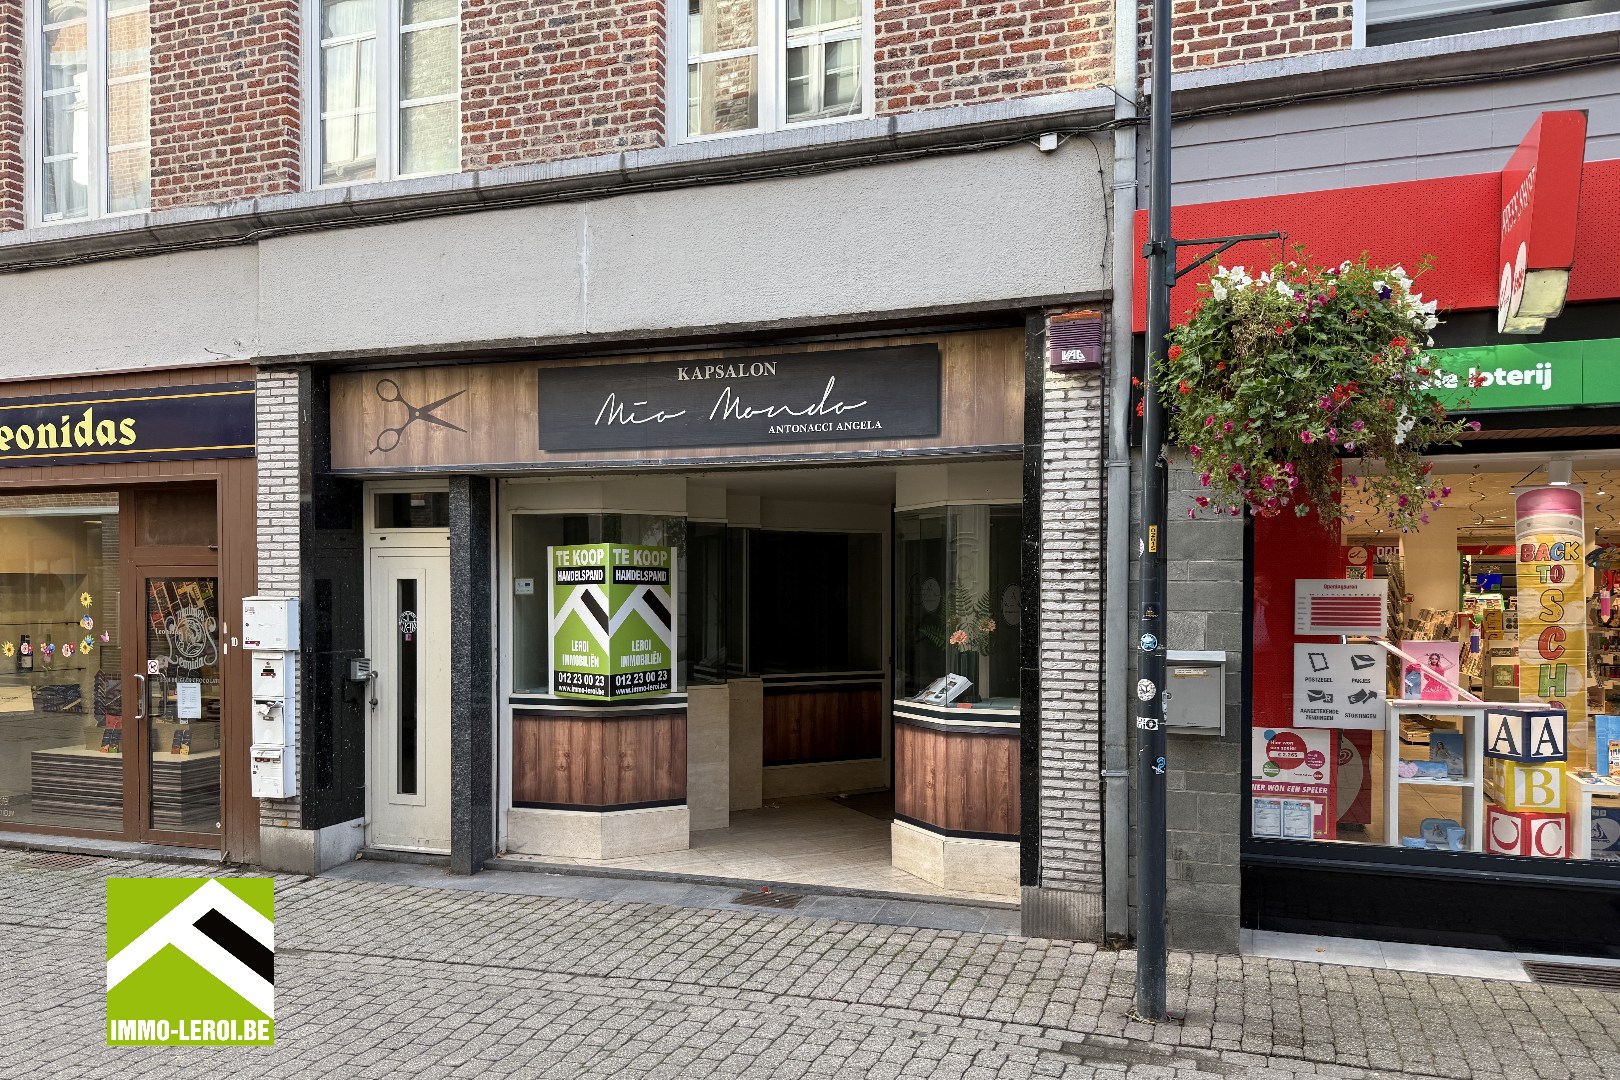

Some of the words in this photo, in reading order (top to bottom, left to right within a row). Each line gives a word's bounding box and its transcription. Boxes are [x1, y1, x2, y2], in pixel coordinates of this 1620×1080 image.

[677, 361, 777, 382] KAPSALON
[594, 392, 686, 426] Mio
[708, 375, 868, 421] Mondo
[768, 422, 833, 434] ANTONACCI
[835, 420, 883, 431] ANGELA
[555, 550, 570, 566] TE
[572, 548, 604, 565] KOOP
[612, 548, 630, 565] TE
[633, 549, 668, 566] KOOP
[1519, 541, 1580, 563] BACK
[557, 569, 604, 582] HANDELSPAND
[615, 569, 667, 582] HANDELSPAND
[1535, 564, 1566, 584] TO
[230, 636, 239, 647] 10
[571, 639, 589, 653] LEROI
[631, 638, 651, 652] LEROI
[562, 653, 599, 668] IMMOBILIËN
[620, 651, 662, 668] IMMOBILIËN
[558, 672, 572, 683] 012
[573, 673, 582, 684] 23
[584, 674, 593, 685] 00
[595, 675, 605, 686] 23
[615, 674, 632, 686] 012
[633, 673, 644, 684] 23
[646, 671, 655, 683] 00
[658, 670, 668, 681] 23
[558, 685, 605, 696] www.immo-leroi.be
[615, 682, 668, 695] www.immo-leroi.be
[1488, 716, 1522, 756] A
[1531, 717, 1563, 757] A
[1267, 784, 1285, 792] WON
[1286, 785, 1301, 793] EEN
[1302, 786, 1328, 794] SPELER
[1519, 768, 1555, 806] B
[1534, 820, 1563, 857] C
